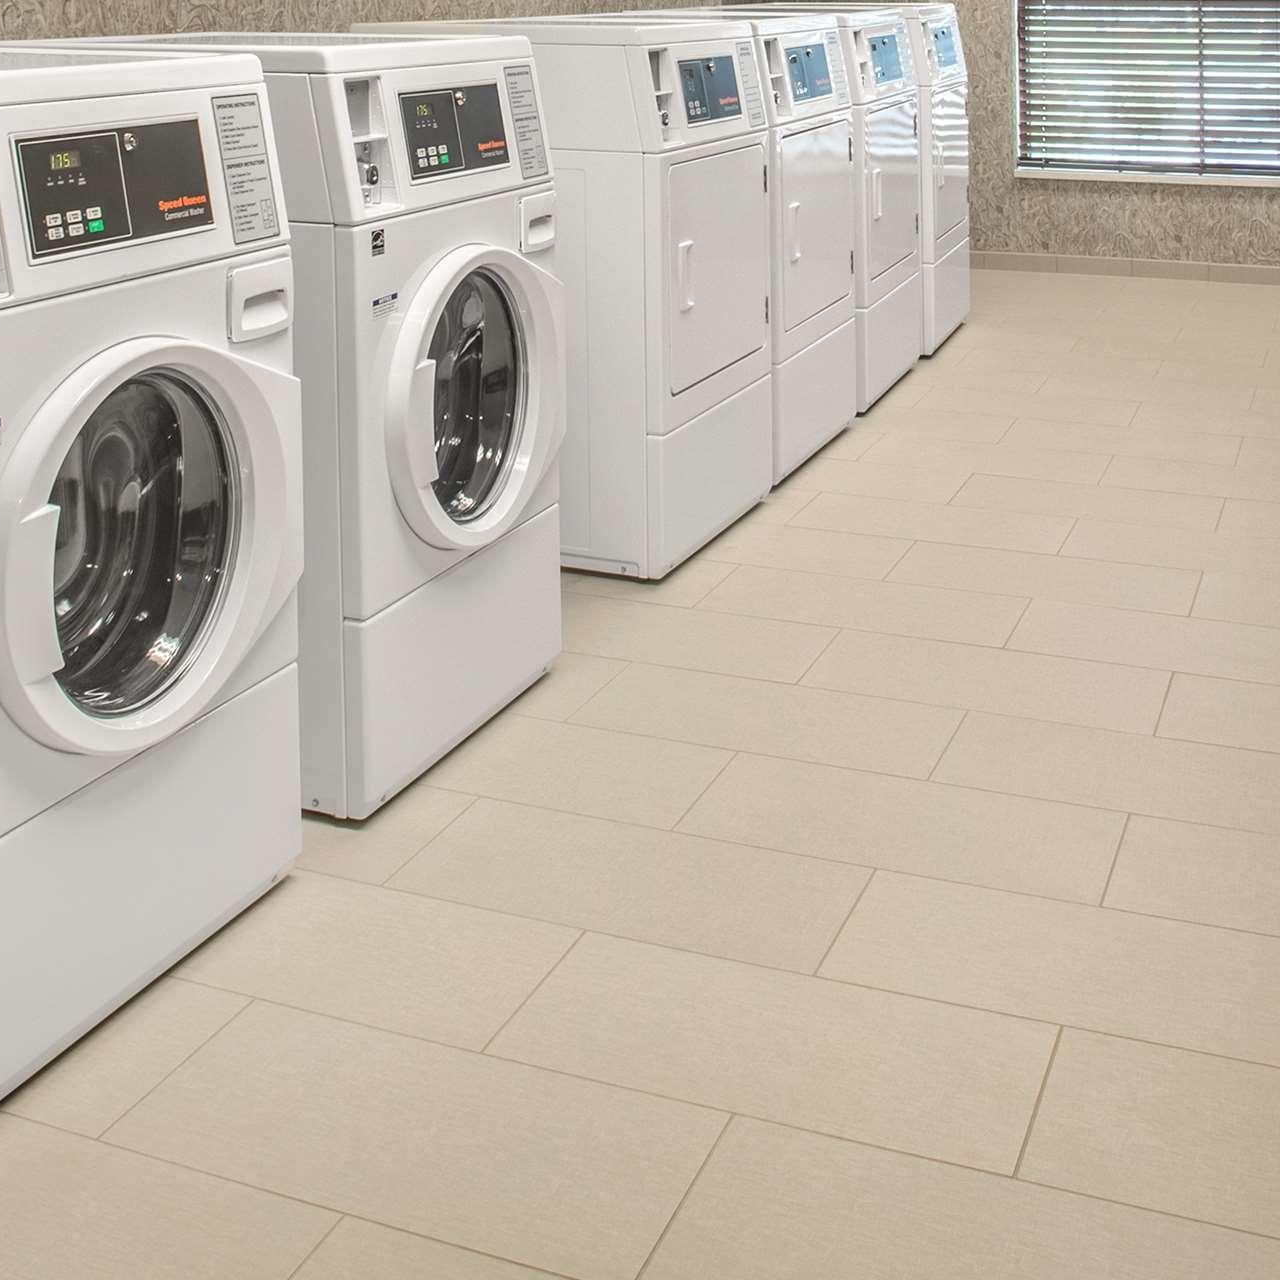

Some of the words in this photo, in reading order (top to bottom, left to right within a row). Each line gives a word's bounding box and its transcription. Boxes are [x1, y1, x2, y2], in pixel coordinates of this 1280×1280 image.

[51, 153, 71, 169] 175
[159, 197, 182, 211] Speed
[183, 195, 207, 206] Queen
